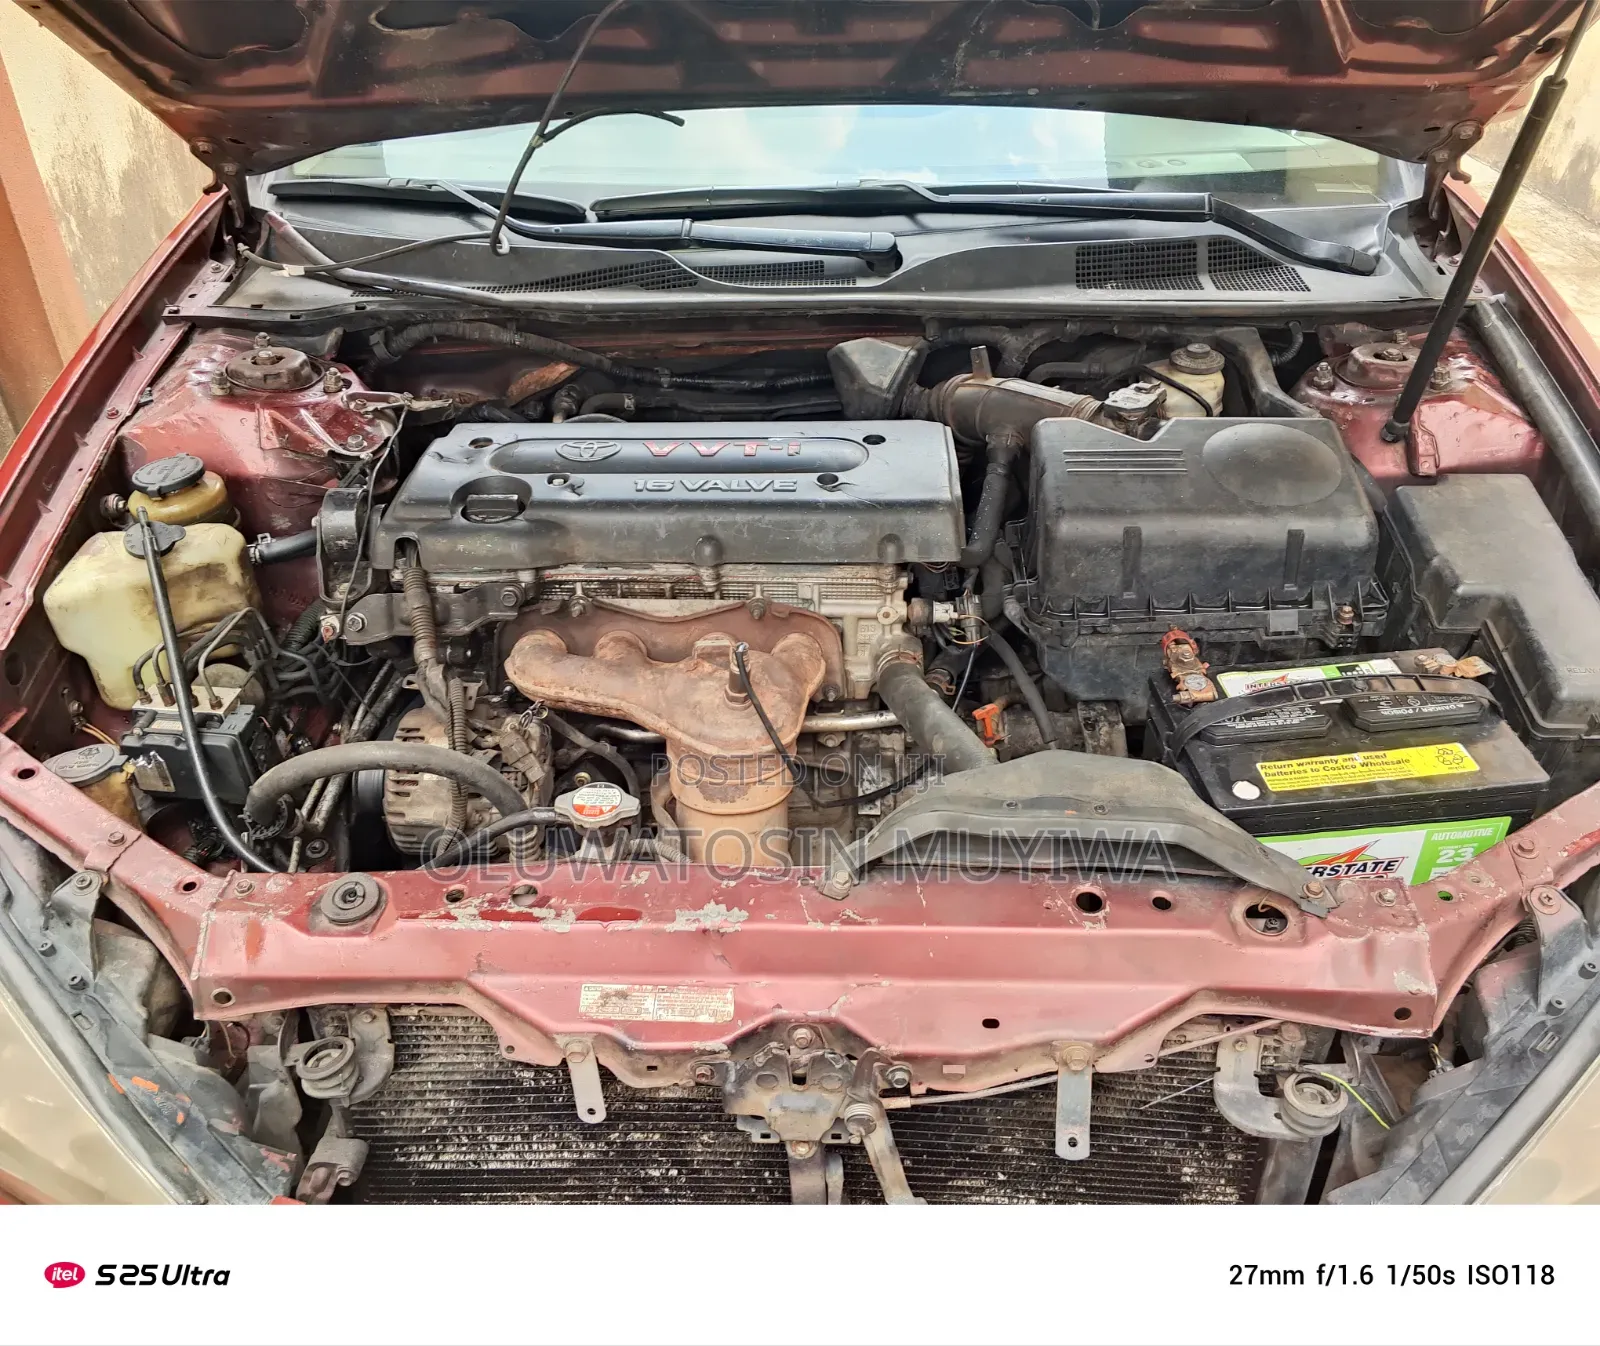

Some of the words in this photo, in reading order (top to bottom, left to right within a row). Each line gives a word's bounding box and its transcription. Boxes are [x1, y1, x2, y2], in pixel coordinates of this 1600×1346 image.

[634, 479, 675, 493] 16
[680, 479, 797, 493] VALVE
[1260, 762, 1294, 771] Return
[1295, 757, 1339, 768] warranty
[1362, 753, 1387, 761] used
[1264, 768, 1308, 778] batteries
[1322, 763, 1357, 772] Costco
[1359, 758, 1411, 768] Wholesale
[1431, 828, 1495, 841] AUTOMOTIVE
